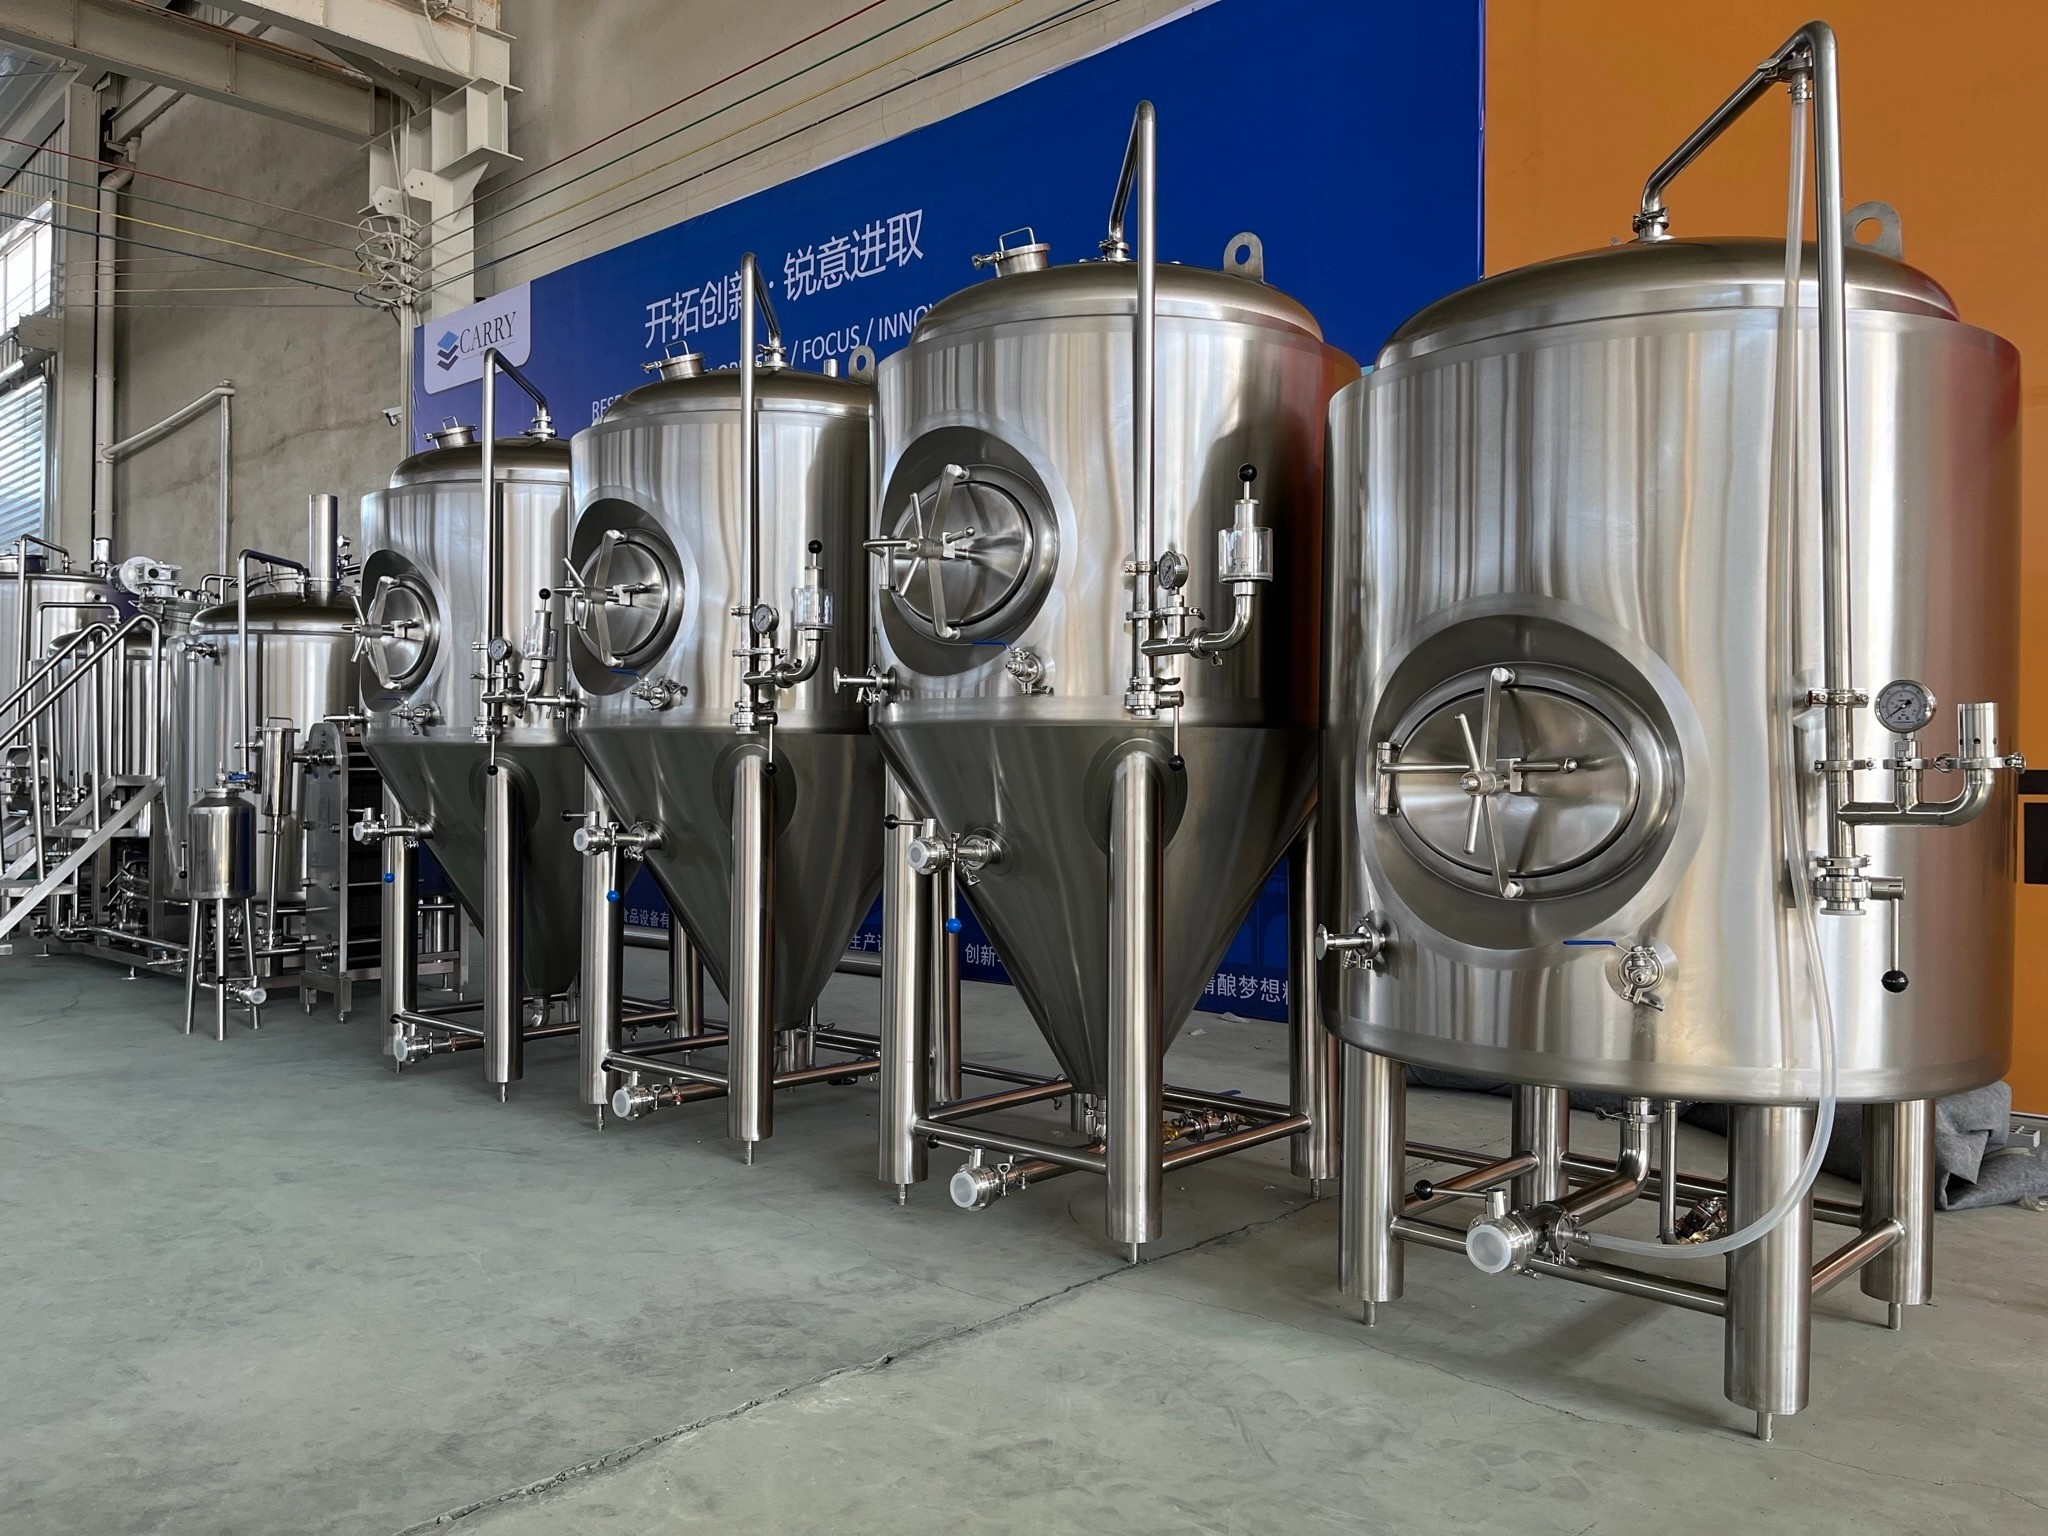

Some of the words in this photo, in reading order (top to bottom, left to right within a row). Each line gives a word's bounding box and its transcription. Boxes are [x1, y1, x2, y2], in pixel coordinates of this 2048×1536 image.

[460, 310, 517, 354] CARRY
[802, 325, 860, 363] FOCUS
[879, 303, 933, 342] INNO
